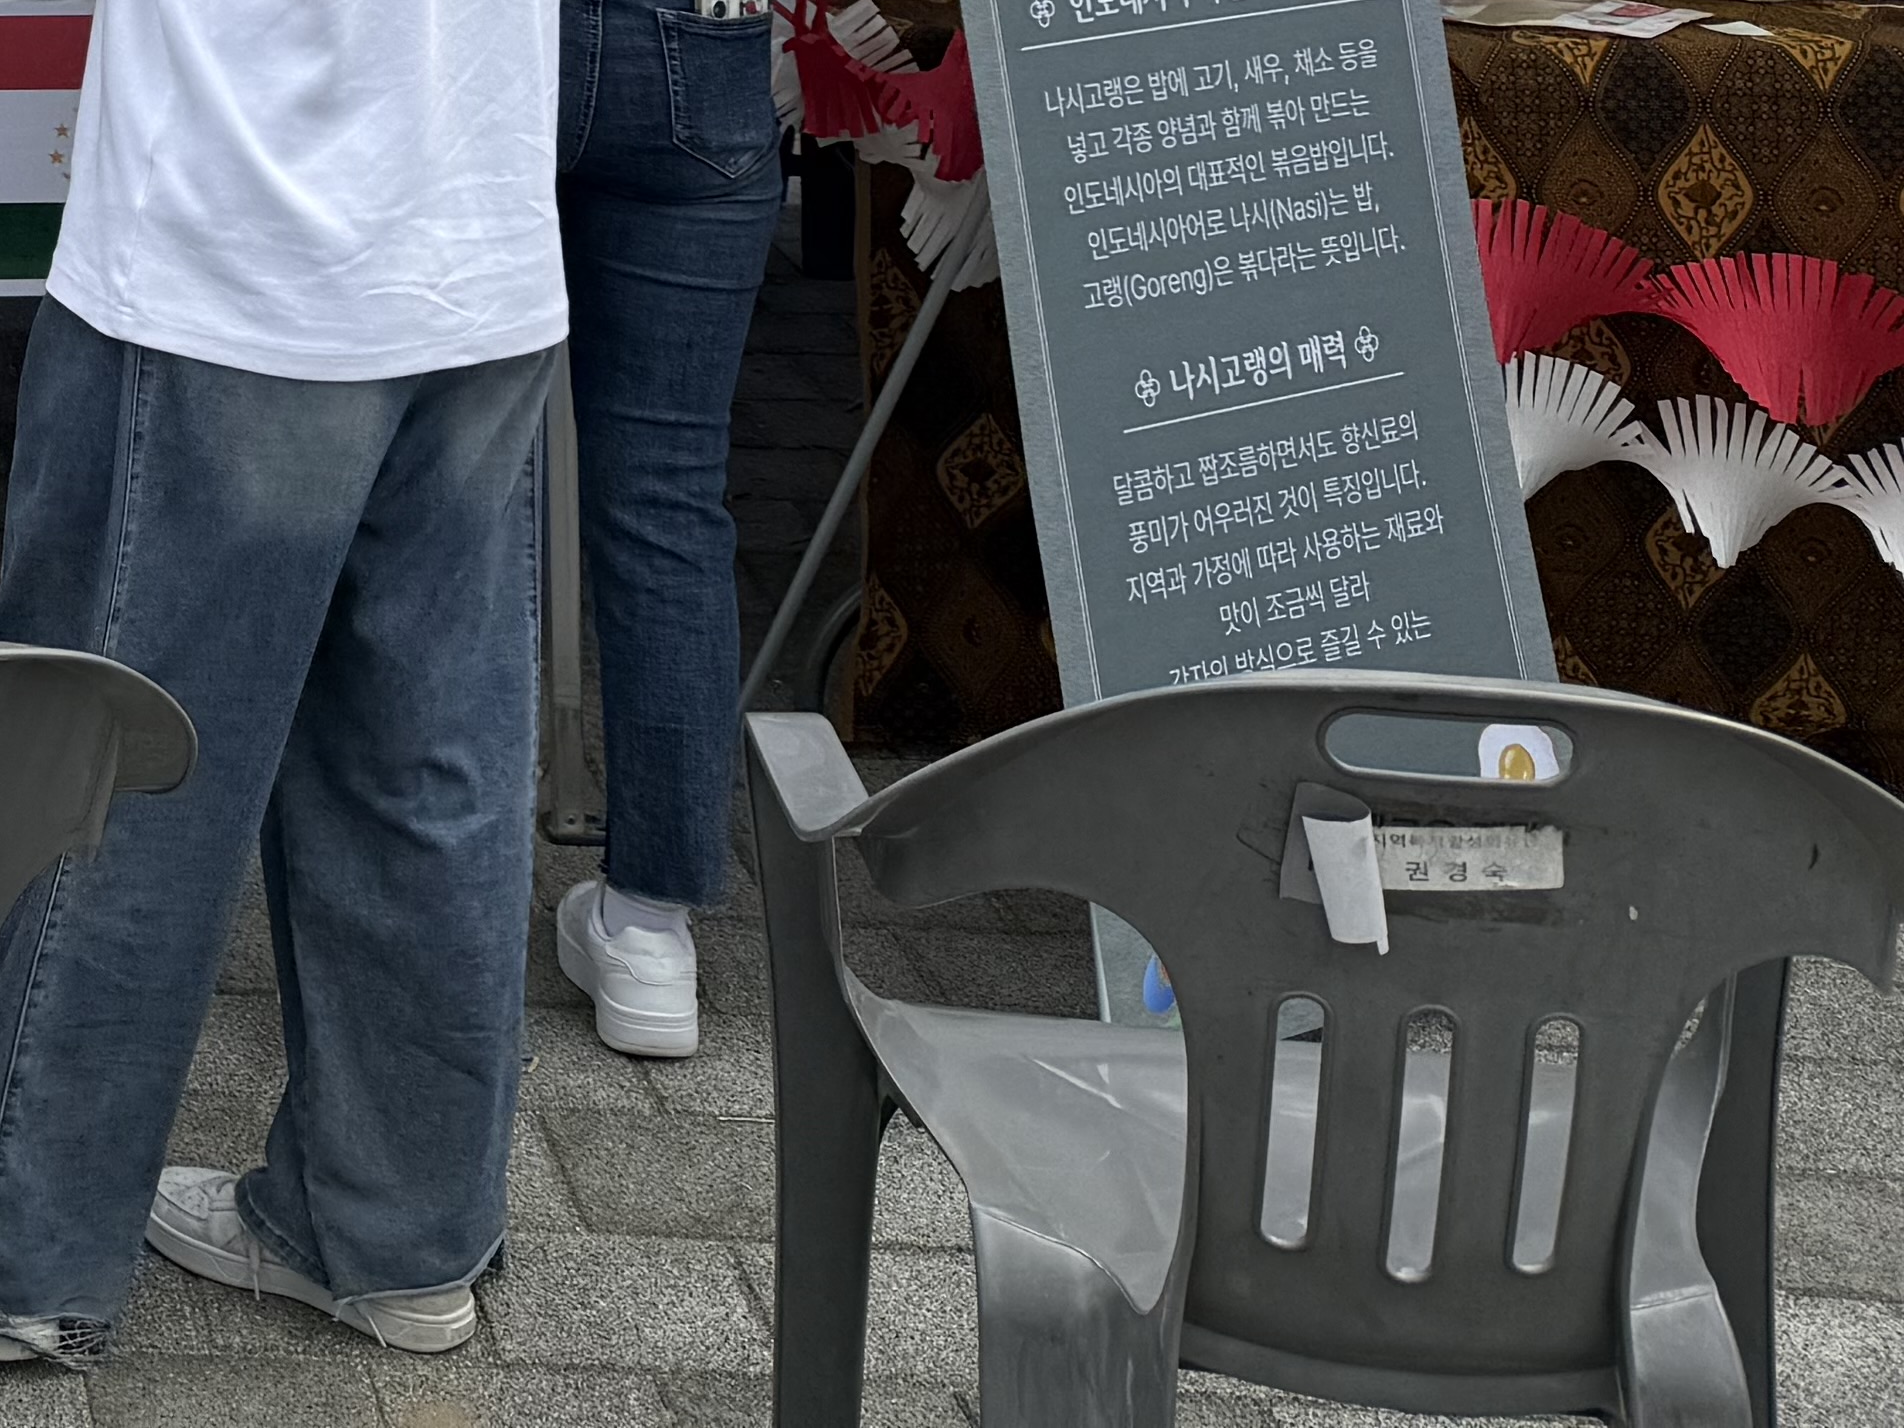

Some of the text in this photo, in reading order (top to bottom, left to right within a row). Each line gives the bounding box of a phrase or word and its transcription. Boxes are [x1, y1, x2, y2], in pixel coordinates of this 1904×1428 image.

[1044, 38, 1378, 119] 나시고랭은 밥에 고기, 새우, 채소 등을
[1067, 88, 1370, 164] 넣고 각종 양념과 함께 볶아 만드는
[1064, 131, 1395, 215] 인도네시아의 대표적인 볶음밥입니다.
[1087, 182, 1379, 261] 인도네시아어로 나시(Nasi)는 밥,
[1083, 224, 1406, 310] 고랭(Goreng)은 볶다라는 뜻입니다.
[1170, 331, 1347, 400] 나시고랭의 매력
[1113, 411, 1419, 506] 달콤하고 짭조름하면서도 향신료의
[1128, 460, 1427, 553] 풍미가 어우러진 것이 특징입니다.
[1126, 504, 1445, 605] 지역과 가정에 따라 사용하는 재료와
[1219, 570, 1372, 636] 맛이 조금씩 달라
[1321, 624, 1361, 661] 즐길
[1367, 623, 1386, 649] 수
[1391, 612, 1432, 644] 있는
